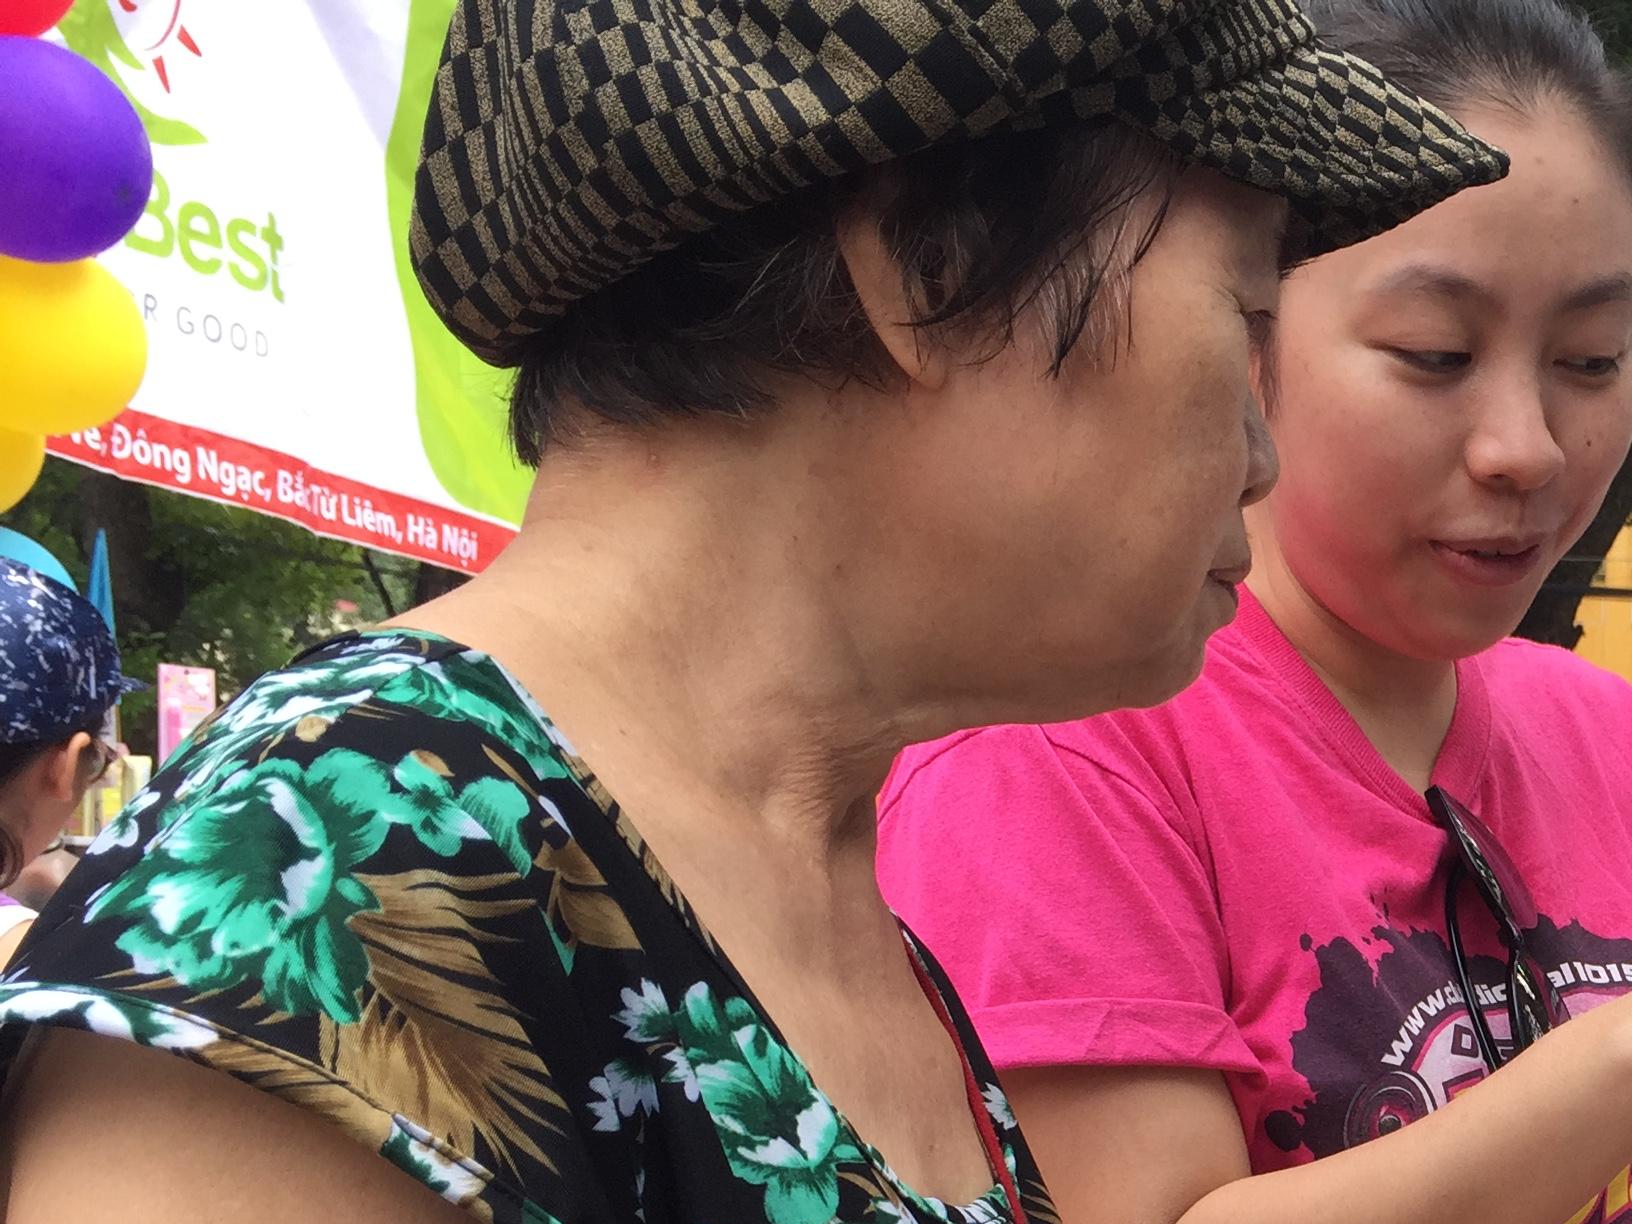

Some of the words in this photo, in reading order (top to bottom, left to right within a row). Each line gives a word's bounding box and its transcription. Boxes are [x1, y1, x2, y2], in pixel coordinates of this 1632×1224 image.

[177, 306, 268, 357] GOOD
[111, 422, 190, 482] Đông
[197, 447, 271, 502] Ngạc,
[341, 494, 403, 544] Liêm,
[407, 517, 438, 550] Hà
[442, 524, 479, 567] Nội
